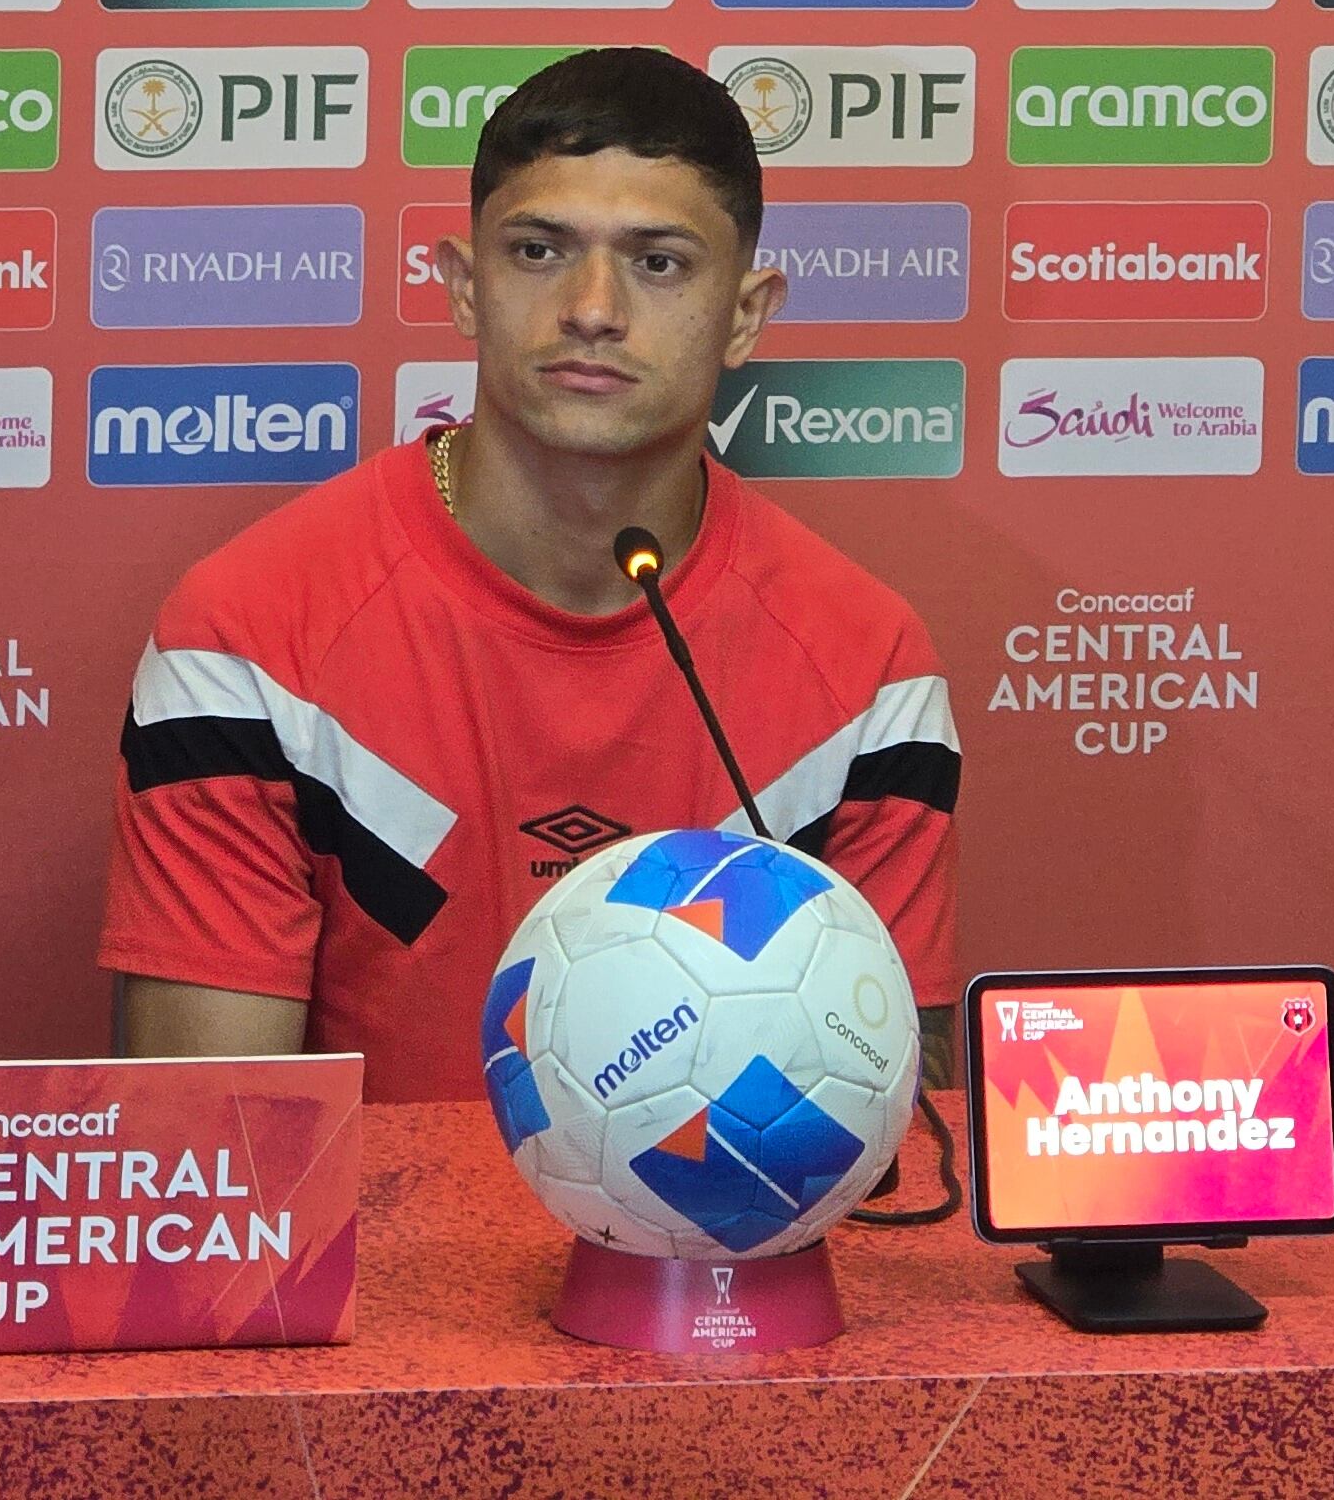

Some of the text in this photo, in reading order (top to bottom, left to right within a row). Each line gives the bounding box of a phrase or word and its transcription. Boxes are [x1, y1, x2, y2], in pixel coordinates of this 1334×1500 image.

[220, 74, 359, 141] PIF
[832, 74, 965, 139] PIF
[1016, 85, 1267, 127] aramco
[145, 252, 354, 282] RIYADH AIR
[900, 248, 960, 277] AIR
[1011, 243, 1260, 281] Scotiabank
[94, 395, 345, 454] molten
[767, 396, 953, 444] Rexona
[1158, 402, 1244, 419] Welcome
[1173, 419, 1258, 437] to Arabia
[1057, 587, 1194, 613] Concacaf
[1005, 624, 1242, 662] CENTRAL
[988, 672, 1257, 711] AMERICAN
[1075, 722, 1167, 754] CUP
[593, 1003, 699, 1099] molten
[825, 1011, 889, 1074] Concacaf
[1053, 1072, 1264, 1117] Anthony
[1026, 1110, 1296, 1156] Hernandez
[692, 1327, 756, 1337] AMERICAN
[694, 1315, 752, 1326] CENTRAL
[712, 1338, 735, 1348] CUP
